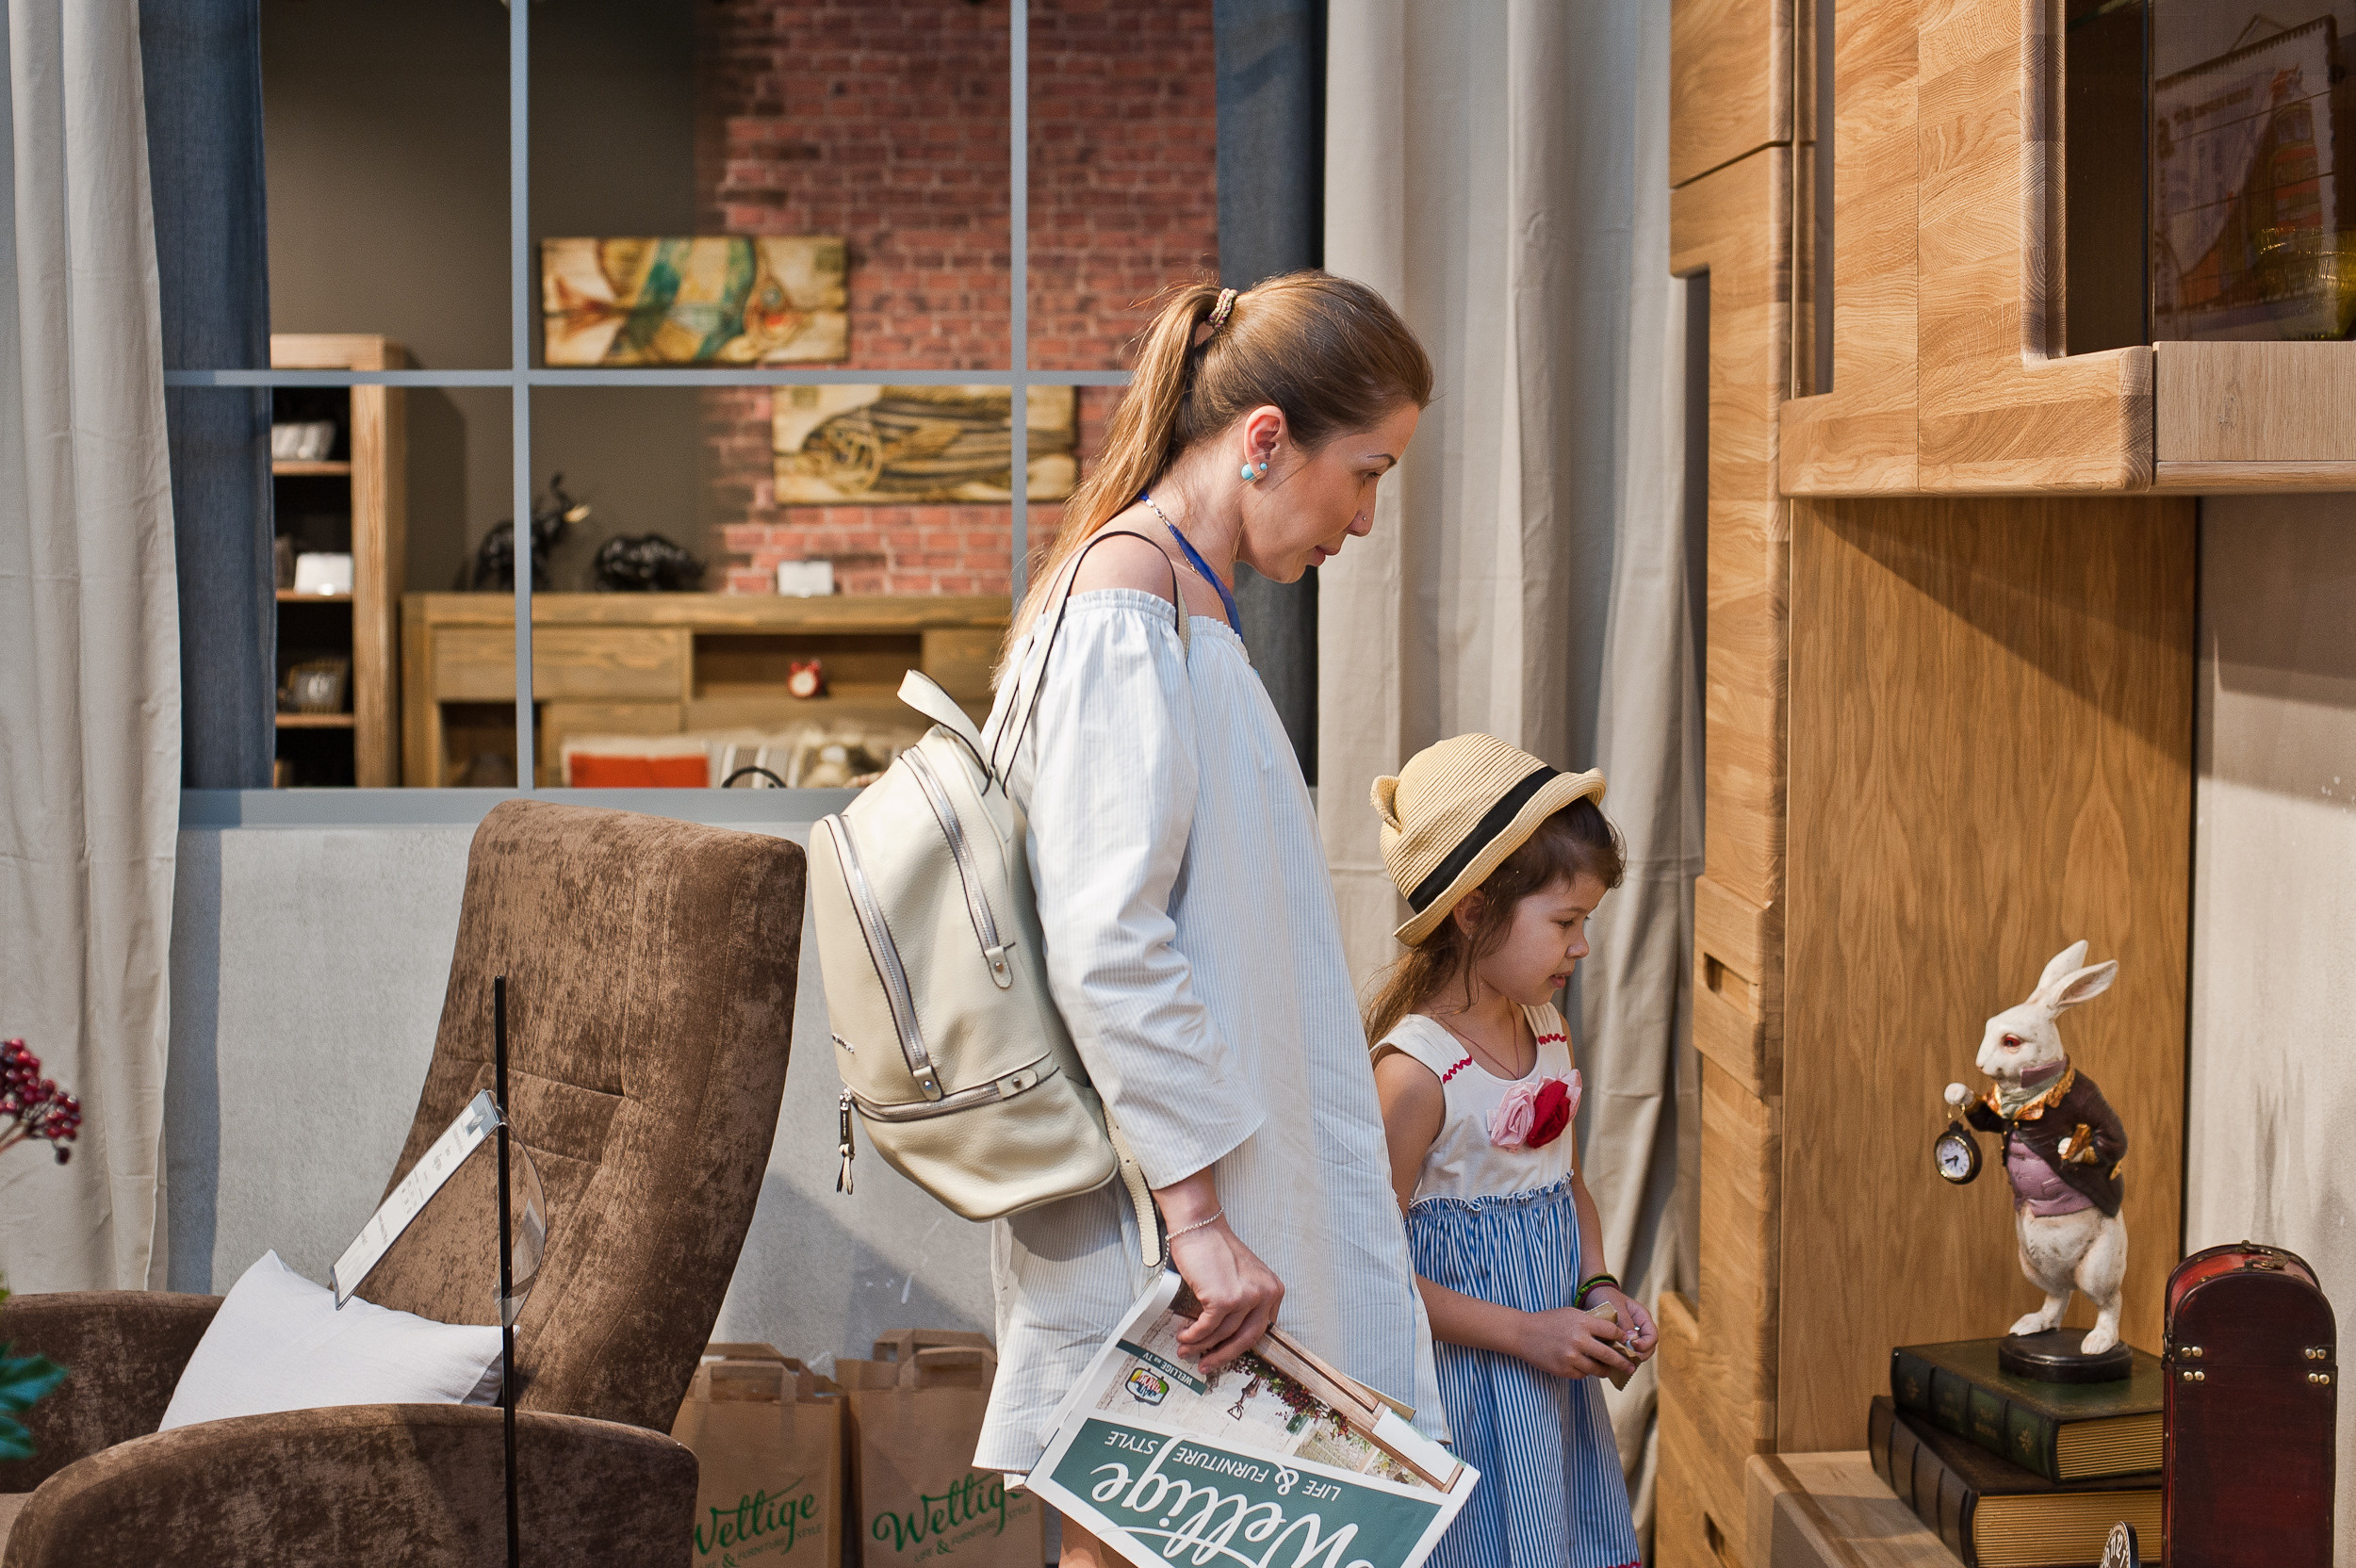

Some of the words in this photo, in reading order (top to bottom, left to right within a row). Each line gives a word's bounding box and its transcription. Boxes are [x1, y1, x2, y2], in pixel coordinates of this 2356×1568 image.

[1142, 1351, 1153, 1361] TV
[1160, 1361, 1193, 1386] WELLIGE
[1104, 1430, 1159, 1455] STYLE
[1172, 1446, 1269, 1483] FURNITURE
[1272, 1462, 1300, 1495] &
[1301, 1479, 1342, 1502] LIFE
[872, 1473, 1025, 1553] Wellig
[2115, 1531, 2123, 1560] 12
